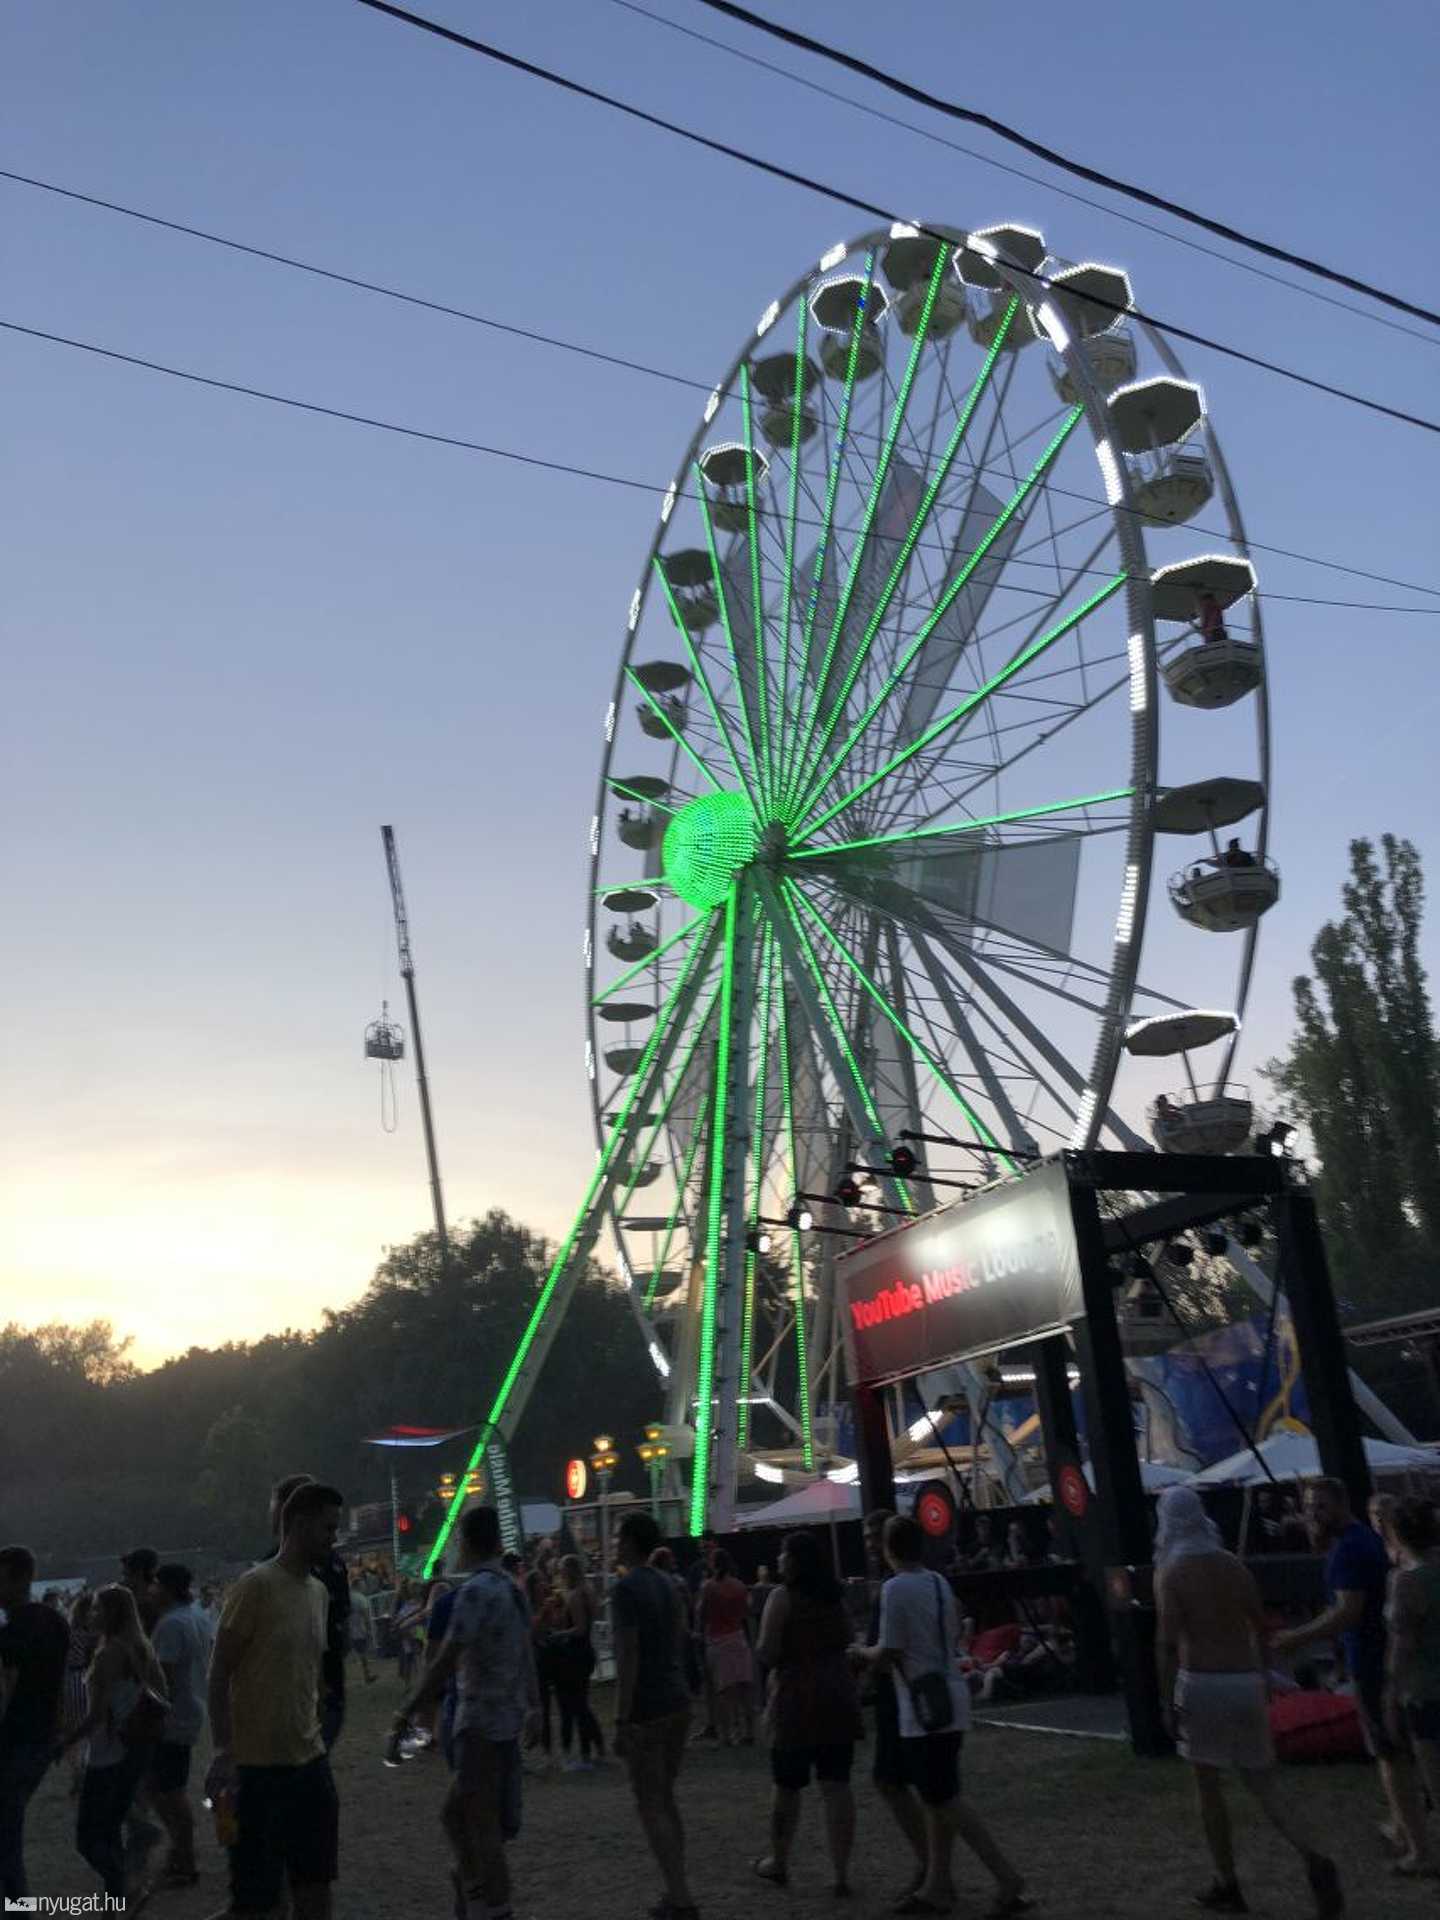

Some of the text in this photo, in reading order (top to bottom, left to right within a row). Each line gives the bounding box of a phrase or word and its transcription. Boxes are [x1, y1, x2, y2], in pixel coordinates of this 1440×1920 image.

[852, 1233, 1058, 1329] YouTube Music Loun
